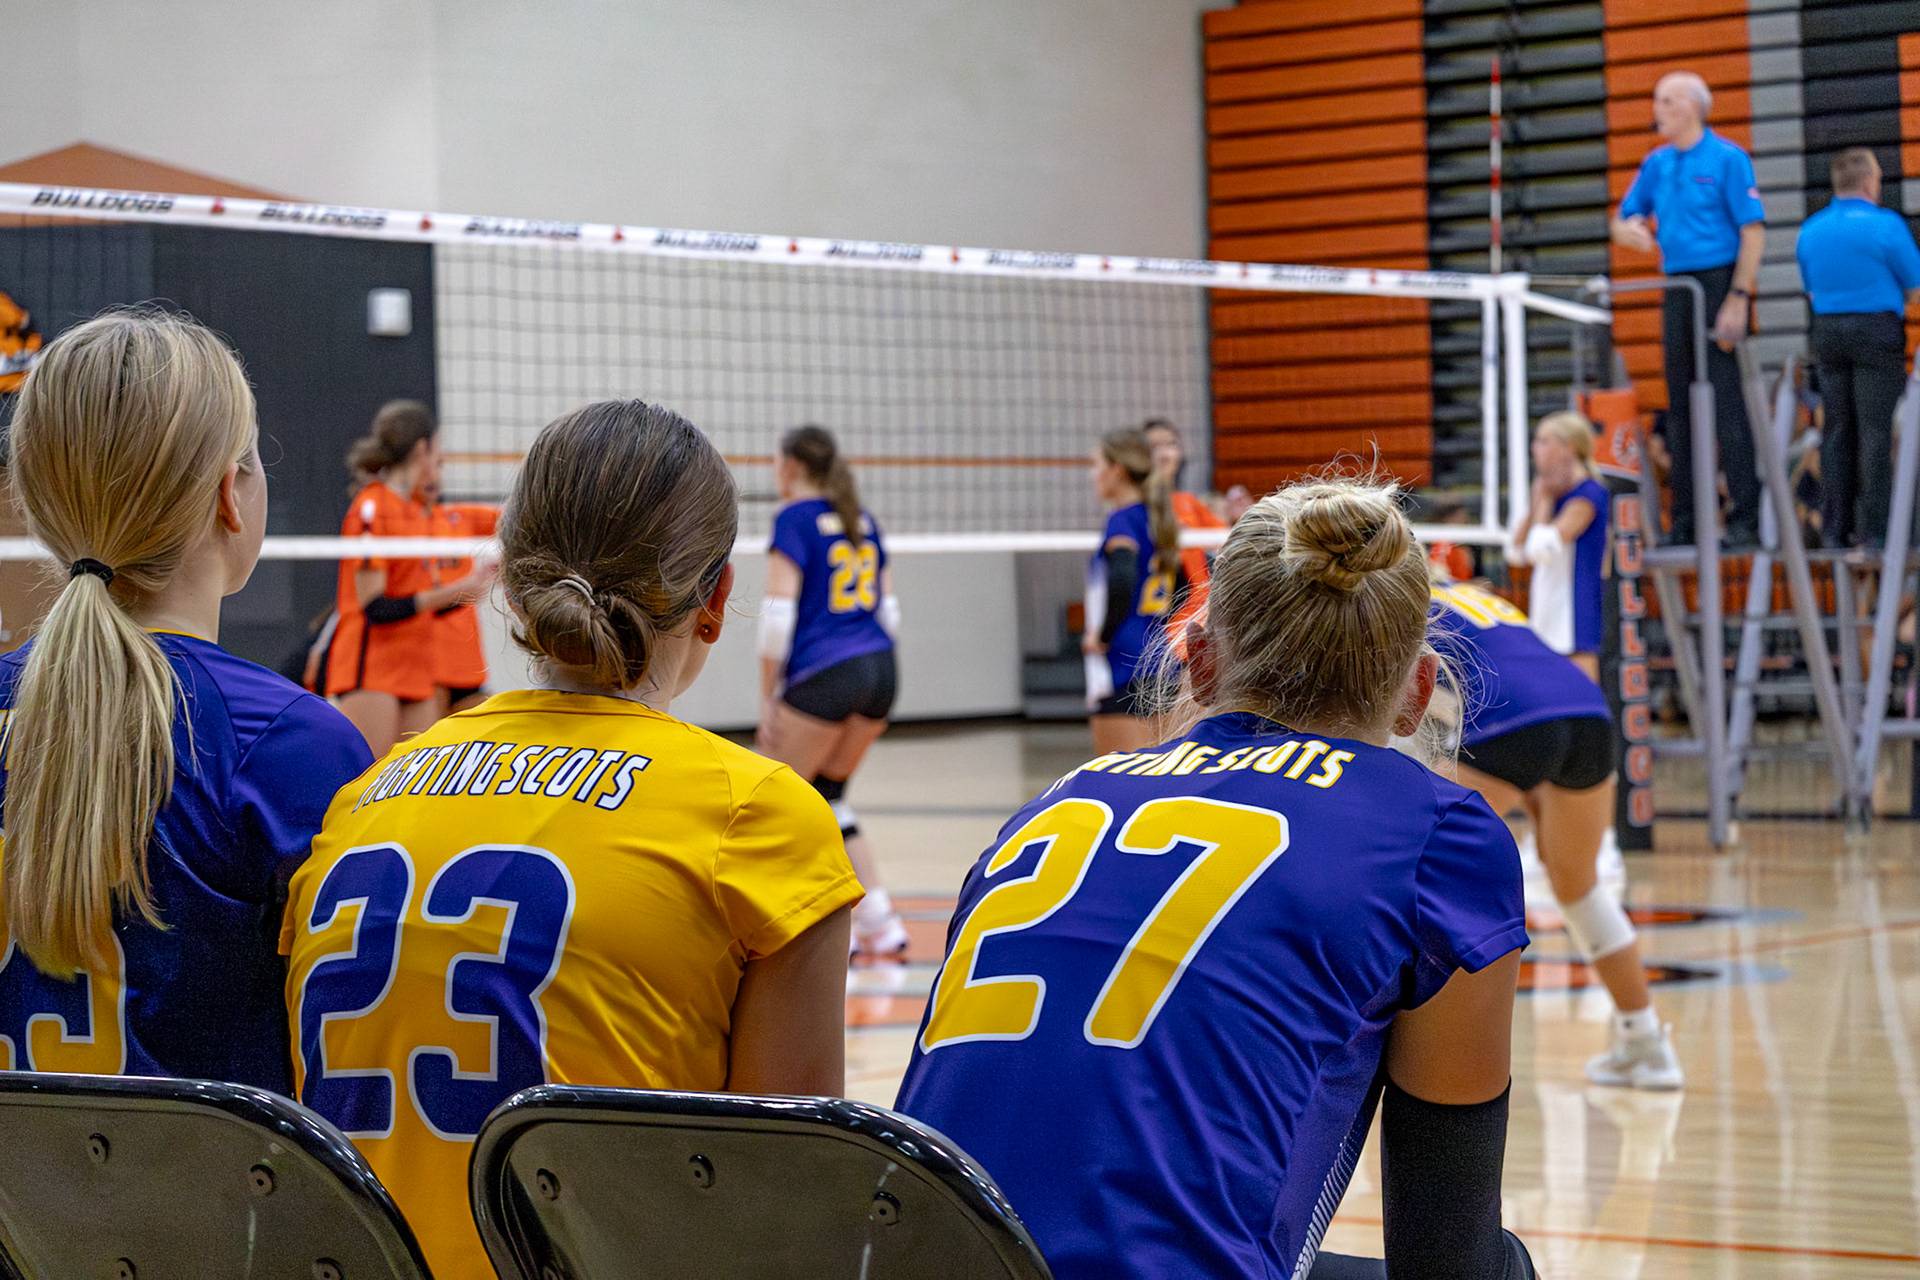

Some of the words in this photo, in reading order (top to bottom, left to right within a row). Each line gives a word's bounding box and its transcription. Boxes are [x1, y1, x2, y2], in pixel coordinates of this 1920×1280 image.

[493, 745, 653, 811] SCOTS
[1199, 740, 1357, 788] SCOTS
[299, 841, 577, 1142] 23
[919, 796, 1290, 1056] 27
